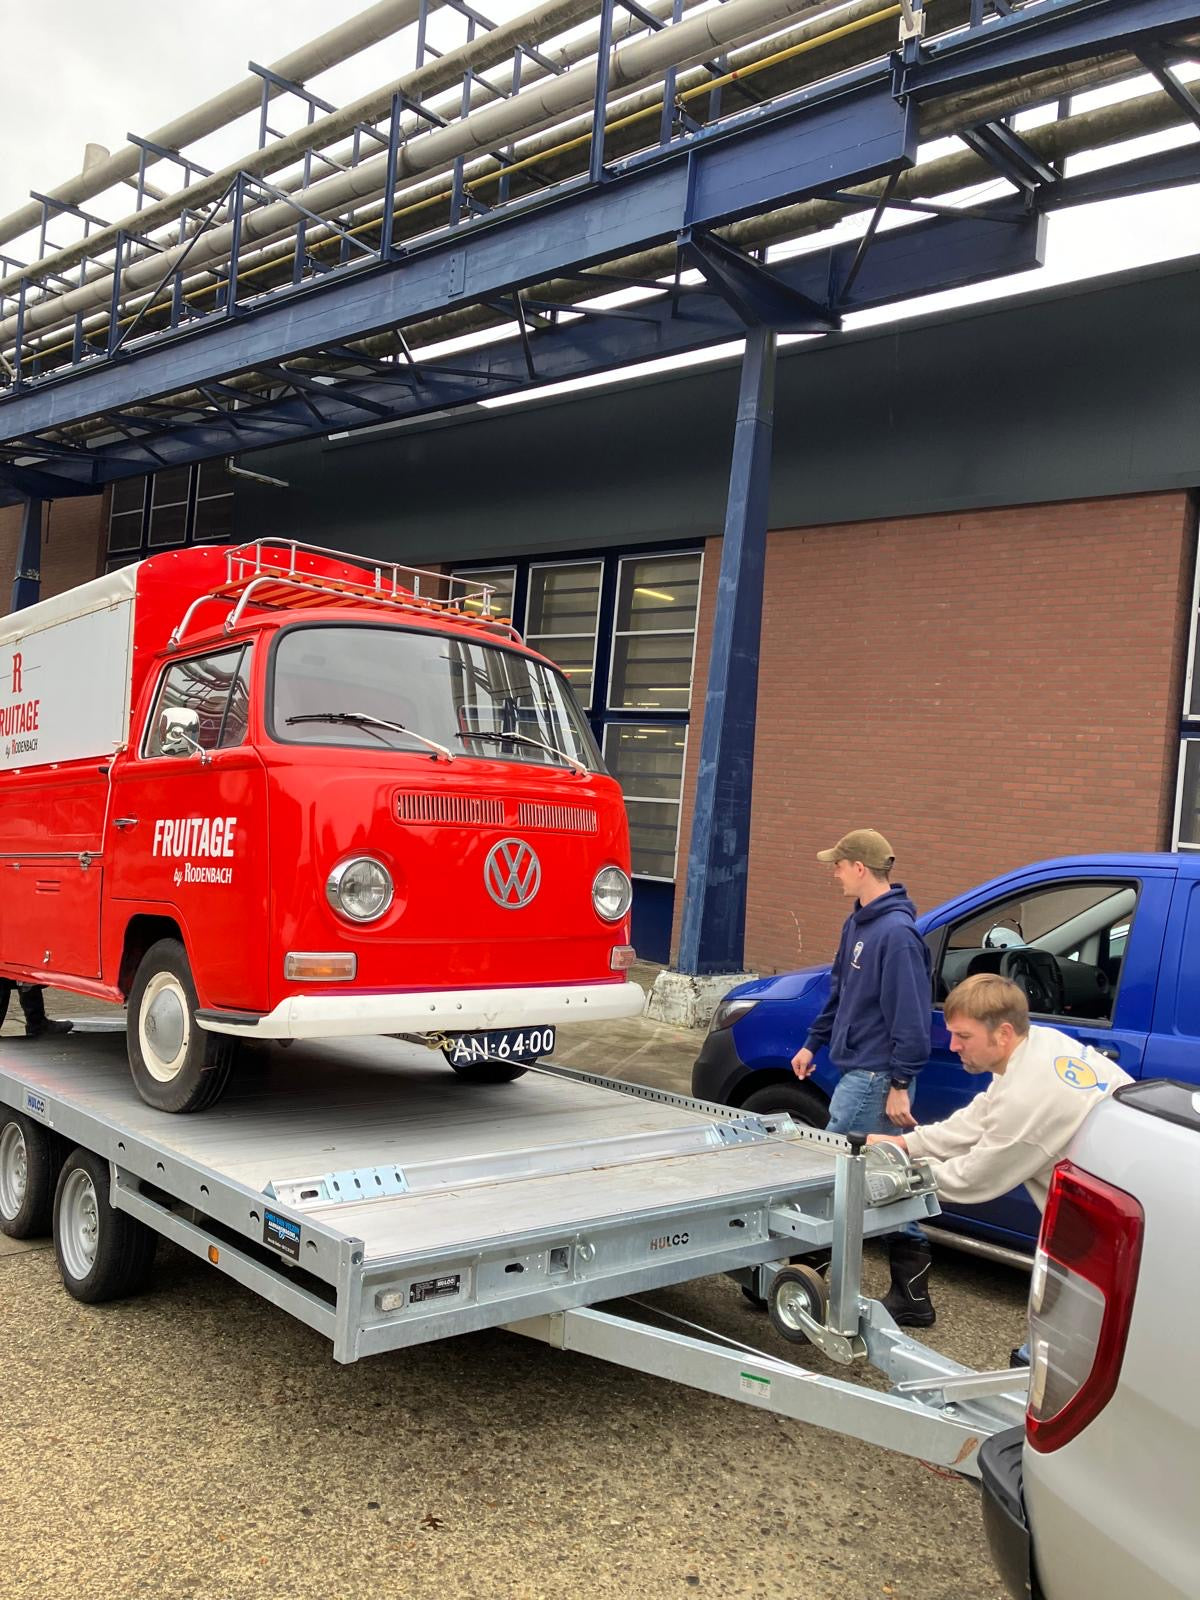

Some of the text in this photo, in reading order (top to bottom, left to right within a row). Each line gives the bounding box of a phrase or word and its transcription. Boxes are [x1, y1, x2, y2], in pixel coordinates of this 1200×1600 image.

[12, 652, 23, 693] R
[5, 744, 11, 759] by
[152, 816, 237, 858] FRUITAGE
[173, 867, 183, 887] by
[1064, 1060, 1084, 1085] PT
[650, 1232, 689, 1250] HULCO
